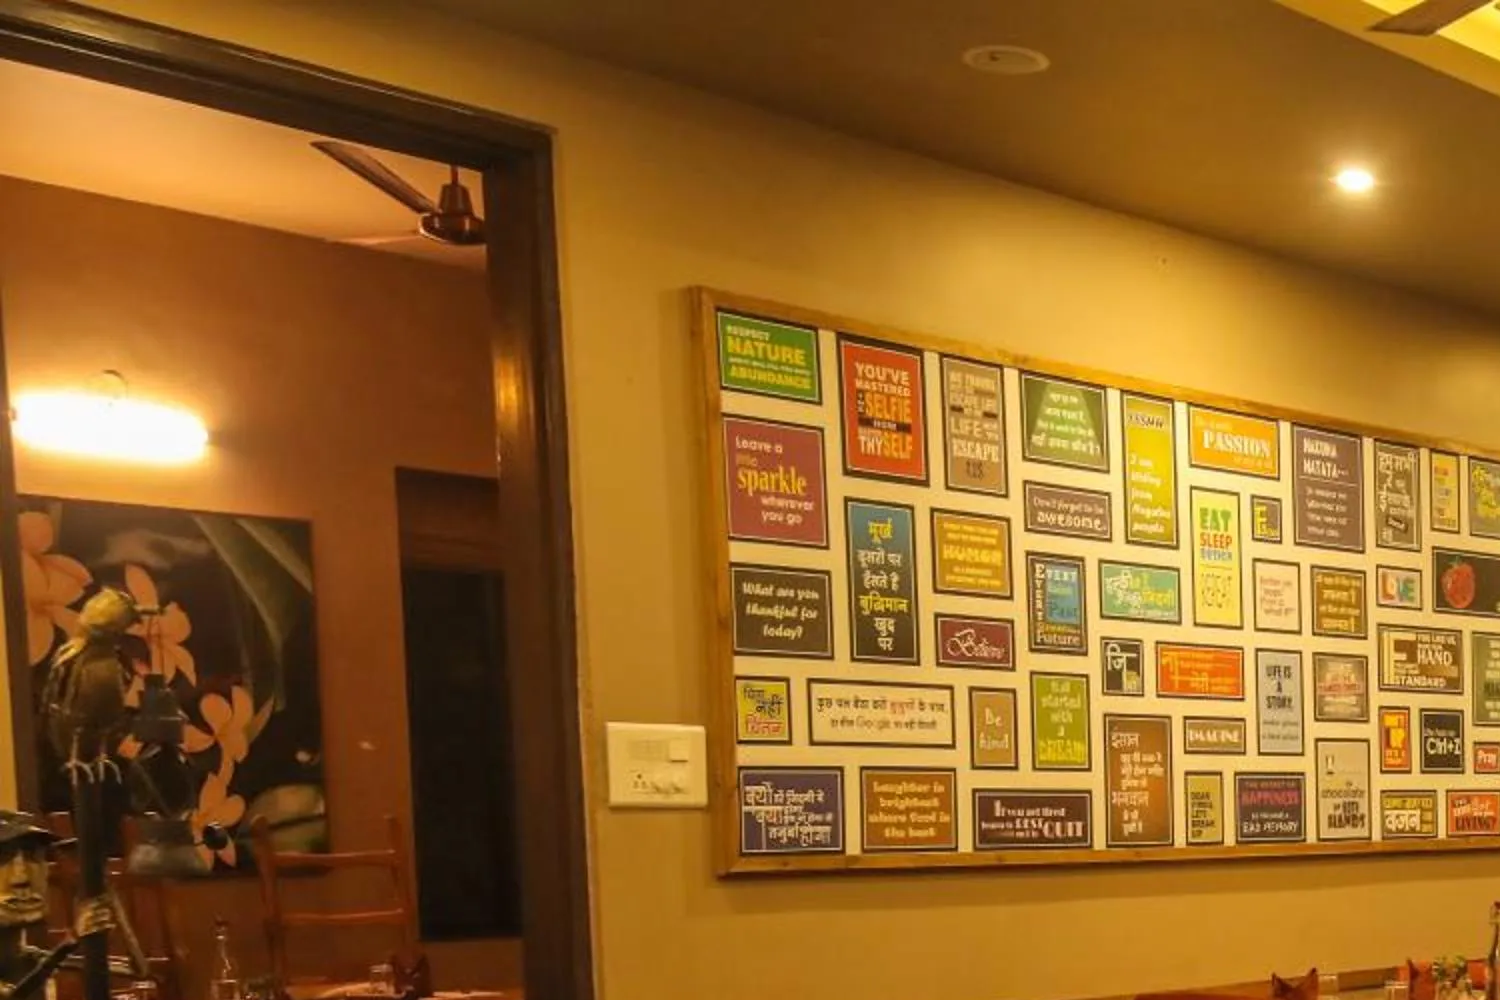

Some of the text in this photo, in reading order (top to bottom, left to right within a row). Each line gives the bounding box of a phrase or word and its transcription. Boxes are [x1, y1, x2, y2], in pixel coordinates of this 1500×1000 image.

[727, 336, 806, 365] NATURE
[730, 365, 812, 389] ABUNDANCE
[854, 362, 910, 386] YOU'VE
[864, 391, 912, 423] SELFIE
[952, 417, 982, 438] LIFE
[736, 435, 784, 453] Leave a
[858, 432, 912, 460] THYSELF
[952, 438, 999, 462] ESCAPE
[1203, 430, 1271, 458] PASSION
[737, 465, 808, 497] sparkle
[761, 496, 814, 511] wherever
[761, 510, 803, 525] you go
[1200, 507, 1232, 532] EAT
[1200, 531, 1233, 548] SLEEP
[742, 582, 819, 601] What are you
[746, 603, 818, 622] thankful for
[762, 624, 803, 640] today?
[1036, 629, 1081, 646] Future
[878, 637, 893, 651] पर
[1418, 648, 1452, 666] HAND
[1426, 737, 1462, 756] Ctrl+Z
[872, 780, 932, 796] Laughter
[1043, 821, 1084, 838] QUIT
[1263, 821, 1297, 834] MEMORY
[1327, 813, 1366, 829] HANDS
[1384, 809, 1421, 832] वजन
